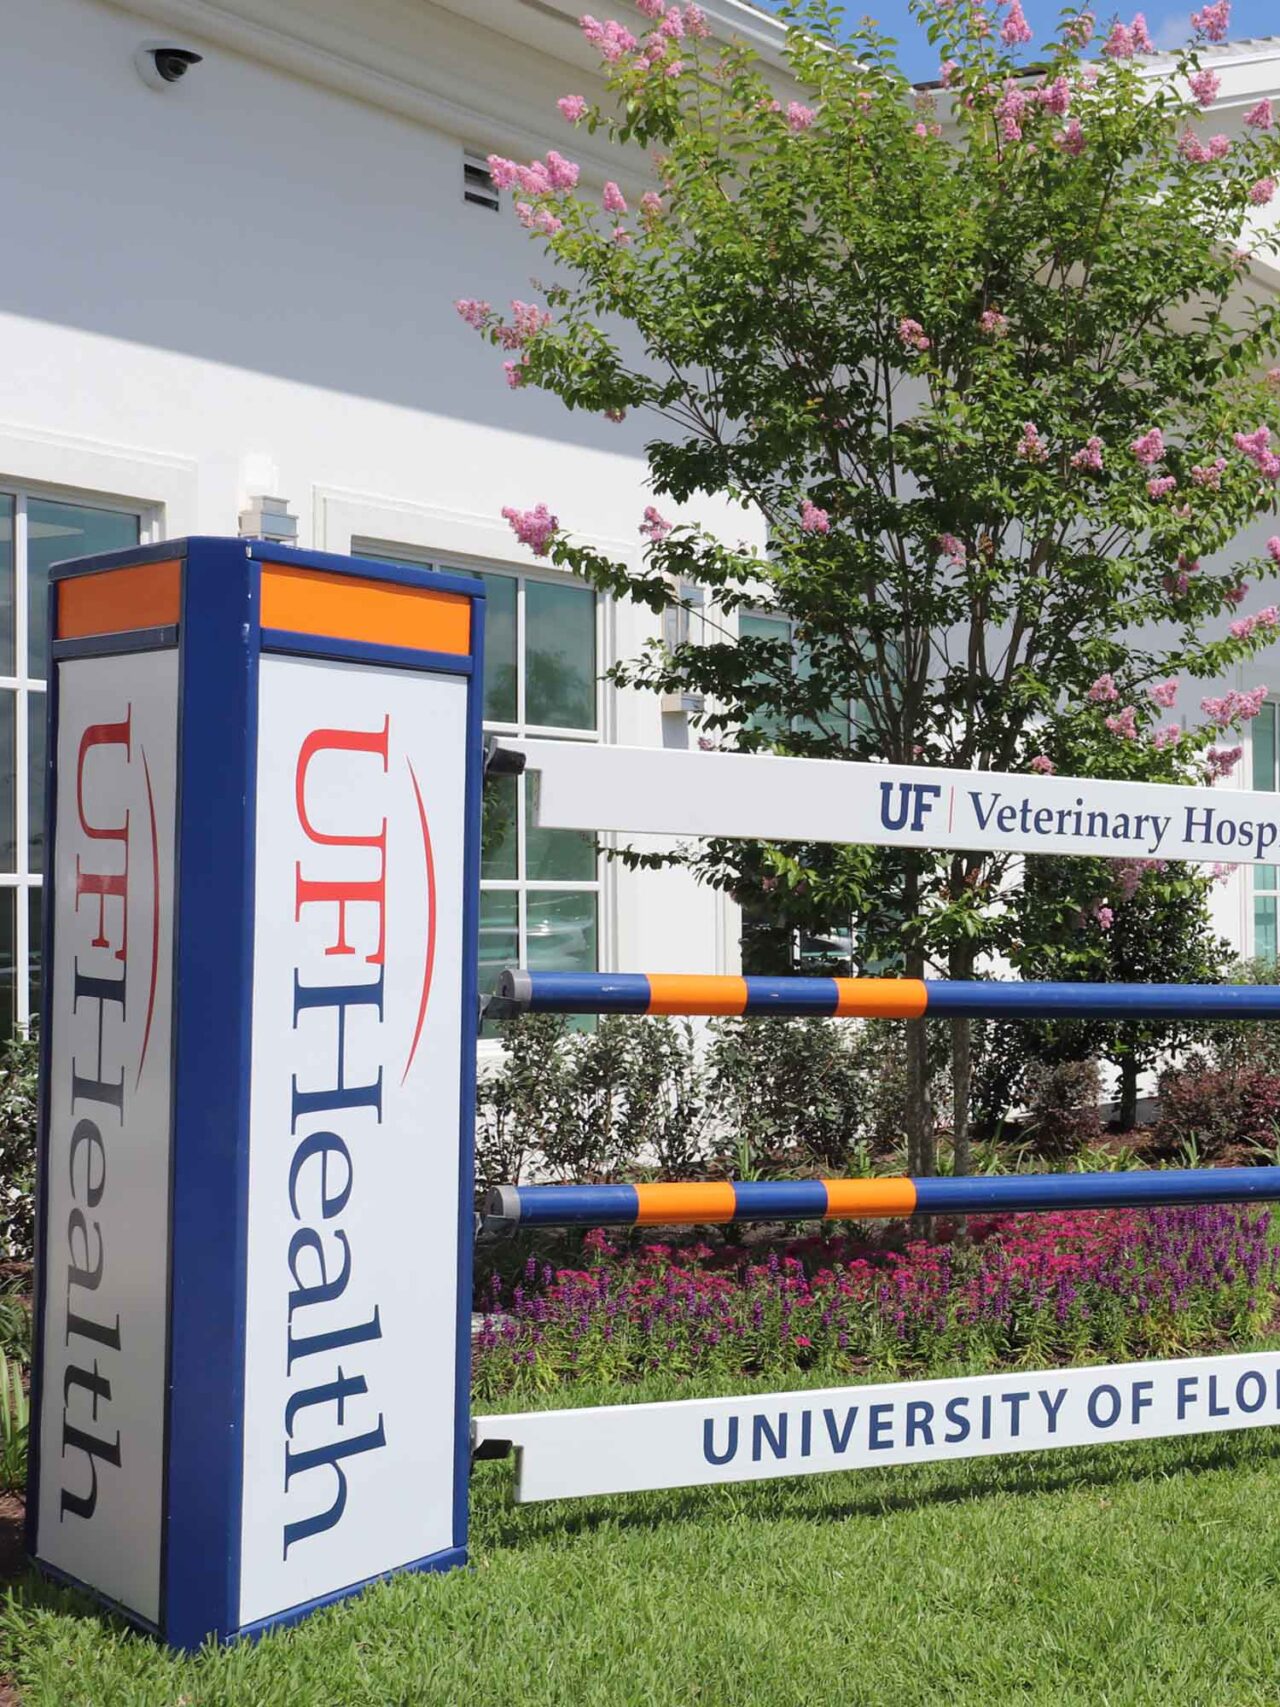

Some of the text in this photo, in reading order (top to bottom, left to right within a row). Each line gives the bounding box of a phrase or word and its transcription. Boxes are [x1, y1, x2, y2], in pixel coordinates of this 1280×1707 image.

[879, 781, 942, 833] UF
[968, 791, 1172, 853] Veterinary
[703, 1388, 1069, 1466] UNIVERSITY
[1087, 1380, 1155, 1429] OF
